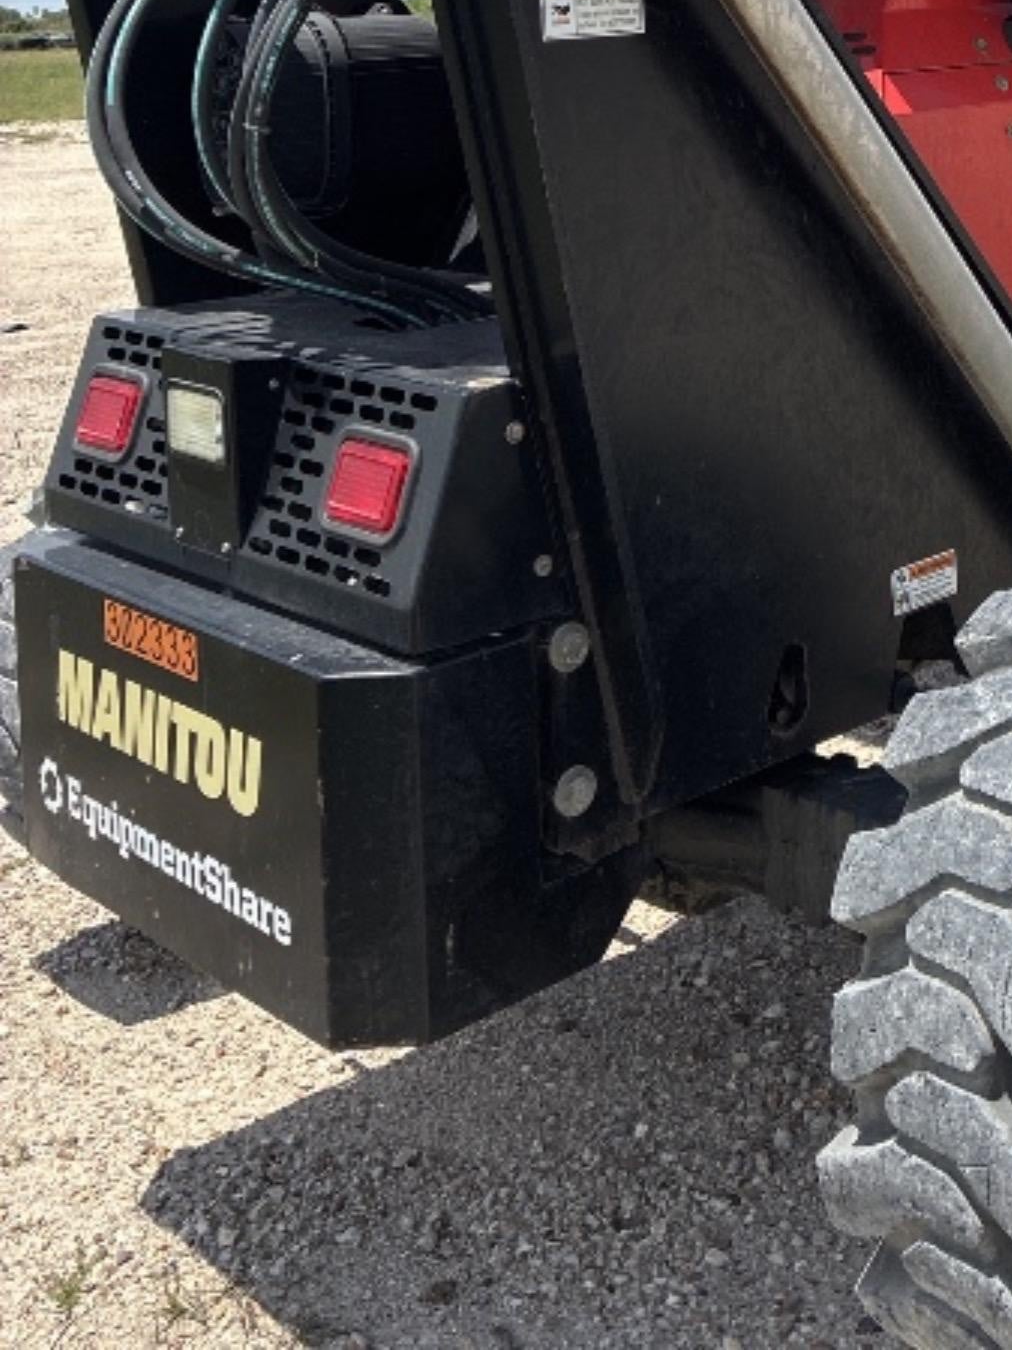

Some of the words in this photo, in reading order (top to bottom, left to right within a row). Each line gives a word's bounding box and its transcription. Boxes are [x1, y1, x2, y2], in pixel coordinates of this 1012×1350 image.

[105, 601, 197, 677] 302333
[58, 648, 262, 818] MANITOU
[66, 774, 293, 946] EquipmentShare
